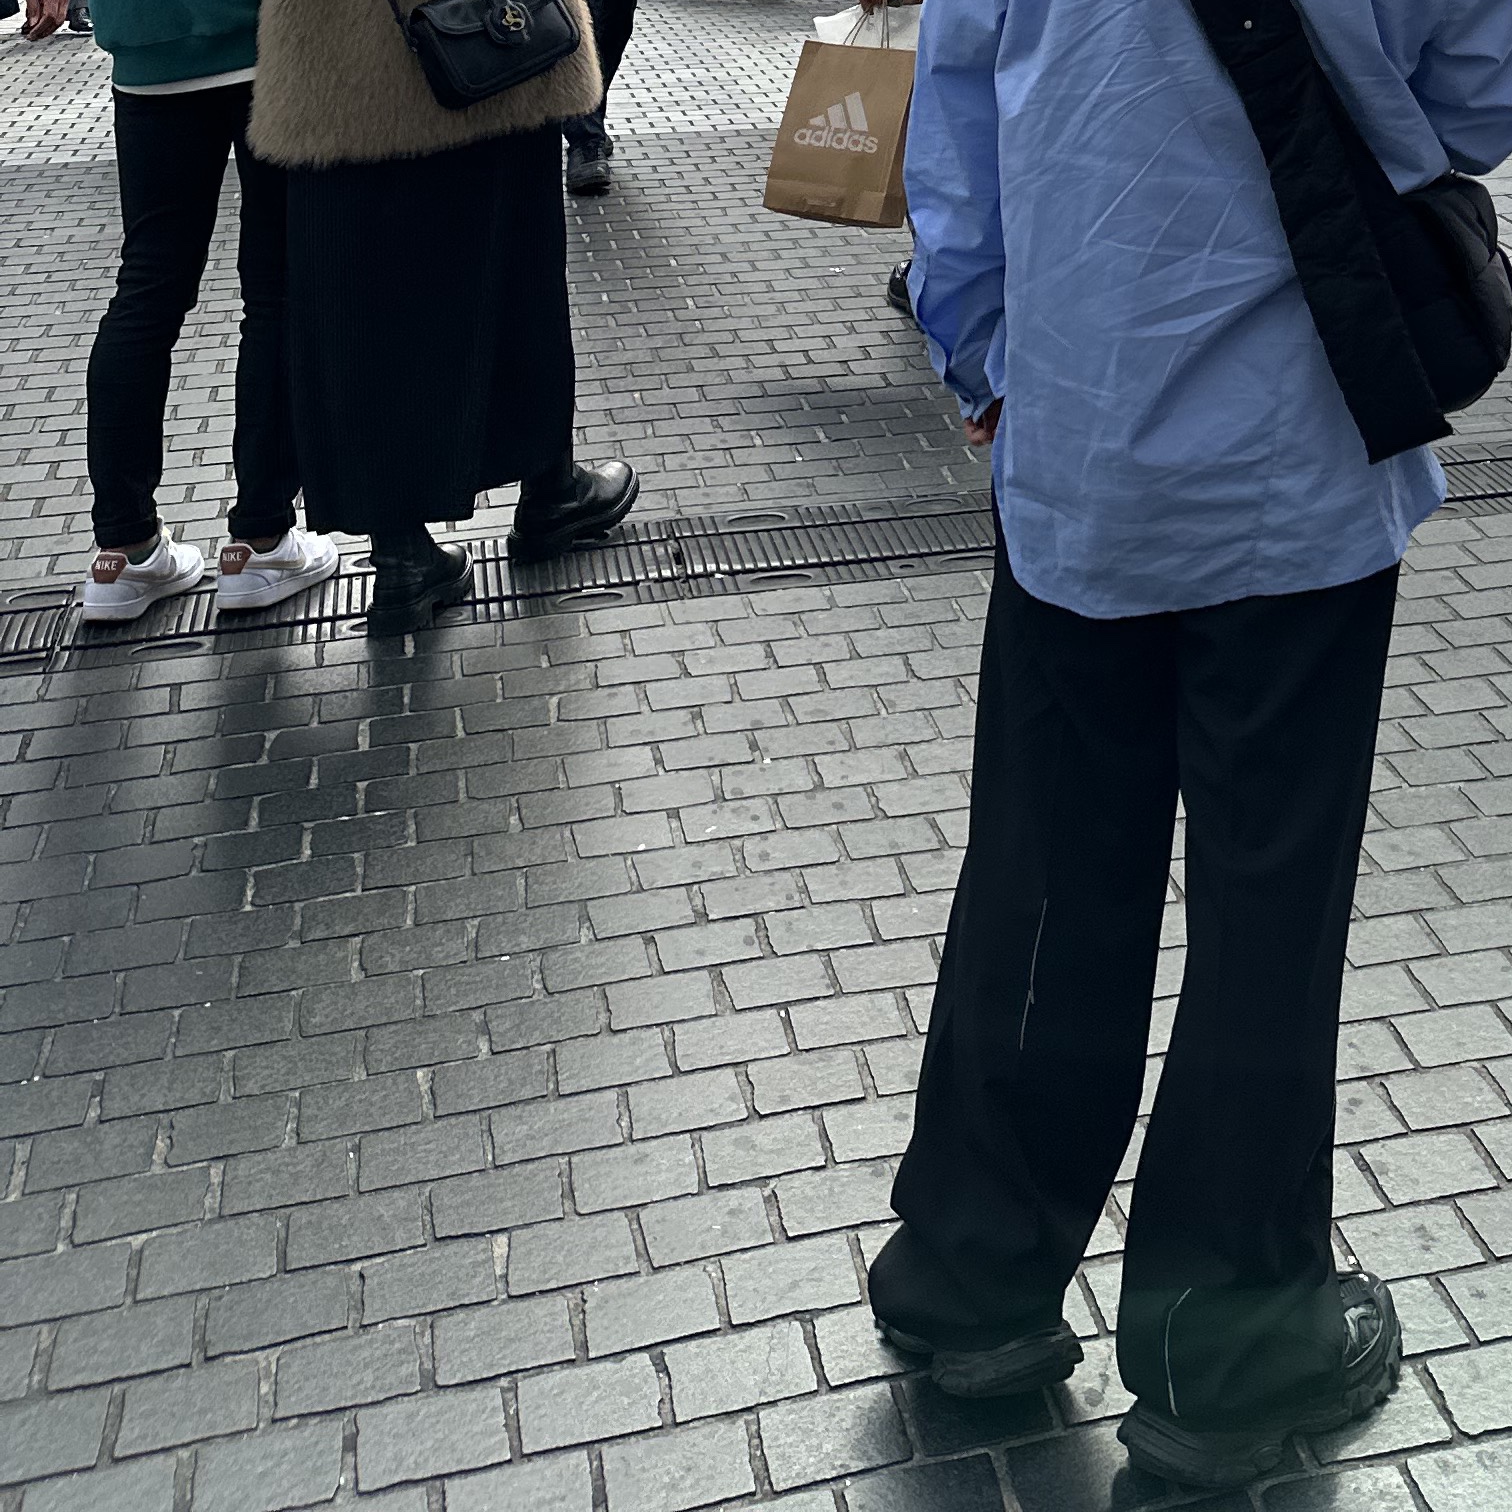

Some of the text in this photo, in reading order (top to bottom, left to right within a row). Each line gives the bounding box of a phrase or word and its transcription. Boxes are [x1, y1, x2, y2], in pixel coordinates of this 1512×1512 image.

[793, 126, 879, 154] adidas
[222, 551, 243, 562] NIKE
[94, 560, 118, 571] NIKE
